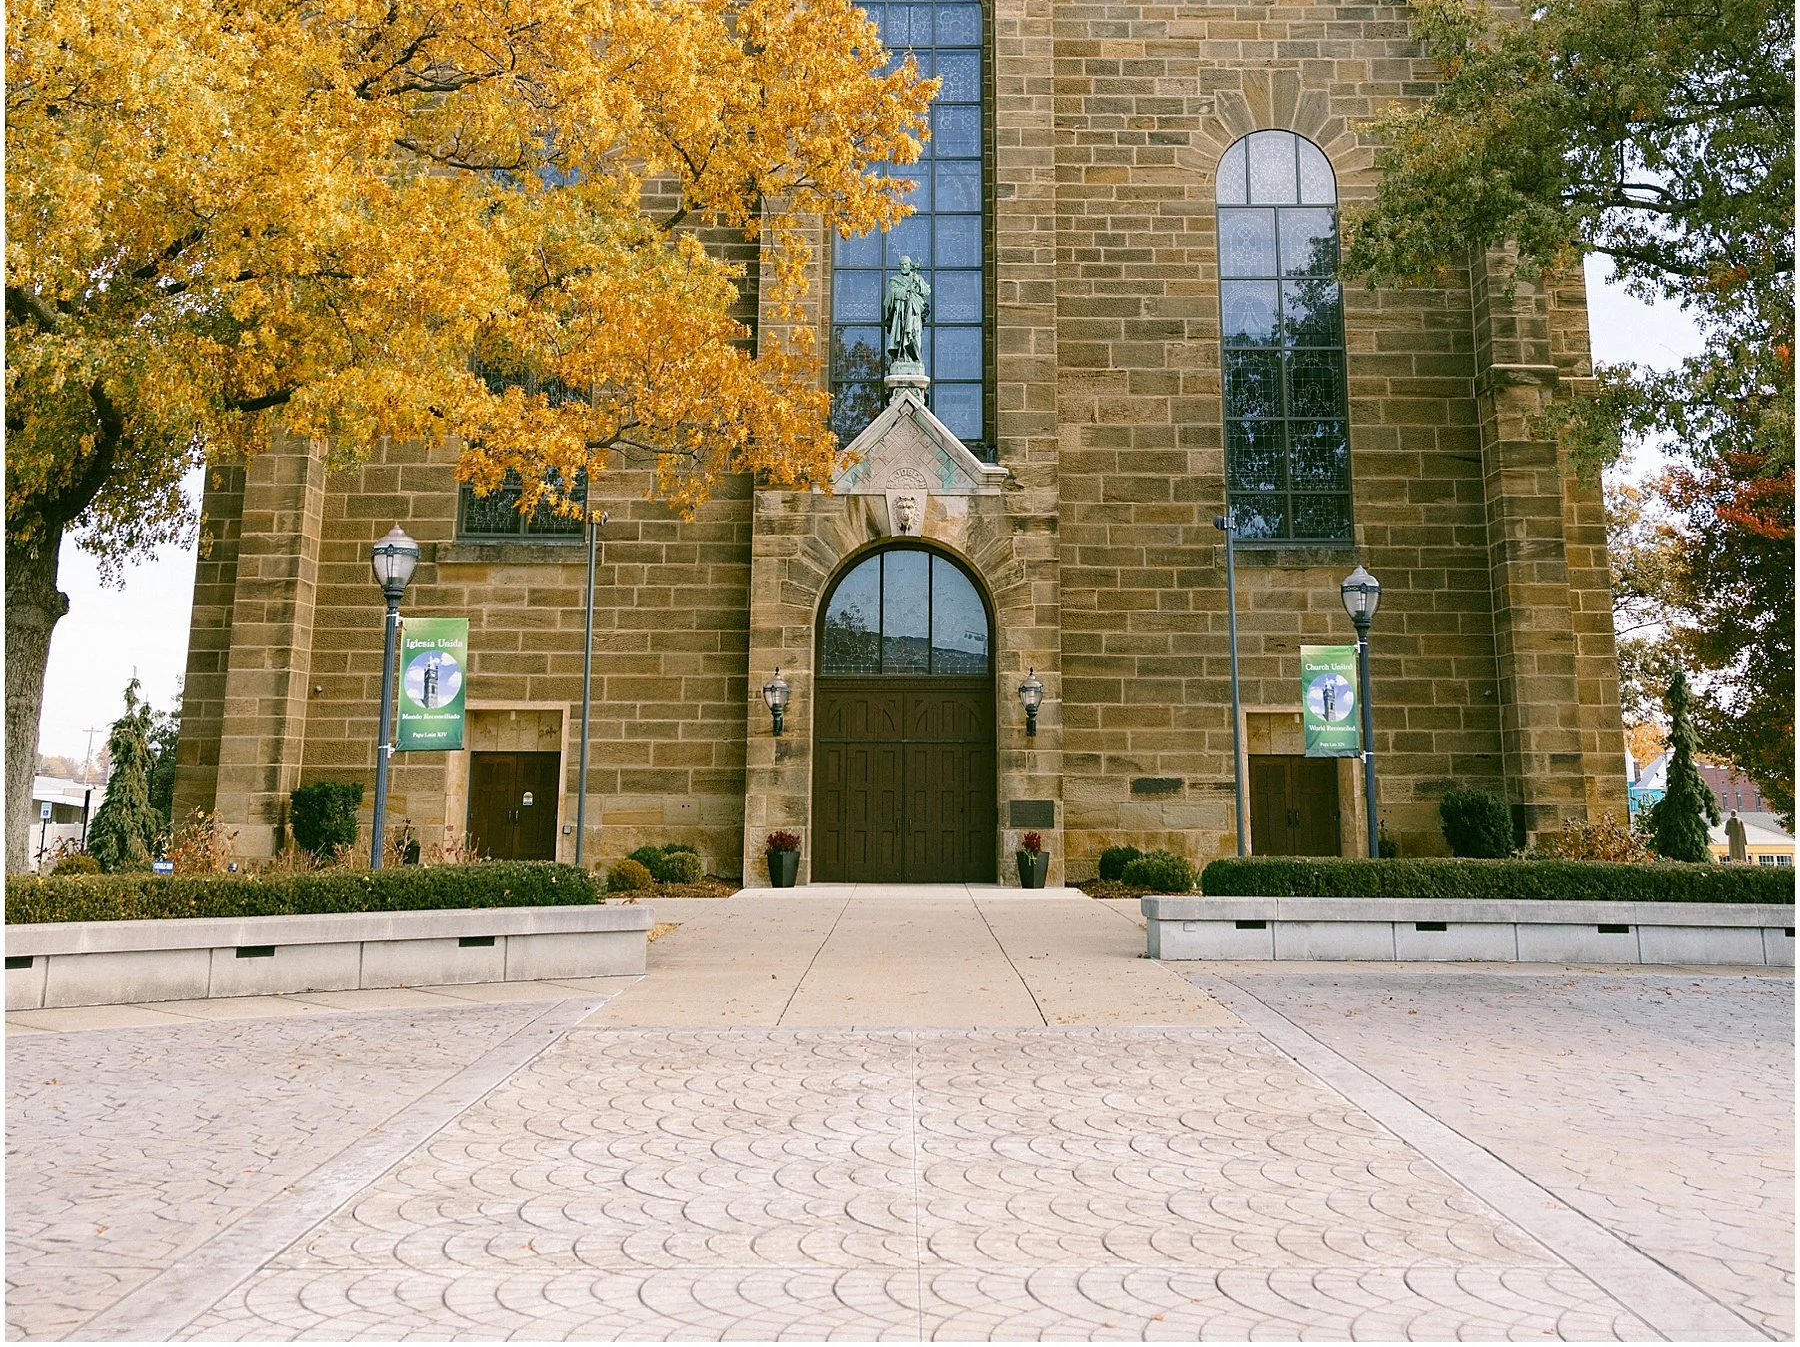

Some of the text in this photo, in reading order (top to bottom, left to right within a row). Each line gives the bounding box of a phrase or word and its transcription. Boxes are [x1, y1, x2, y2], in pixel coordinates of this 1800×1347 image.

[894, 469, 927, 488] JOSEPH
[406, 639, 463, 649] Iglesia Unida
[1305, 663, 1353, 671] Church United
